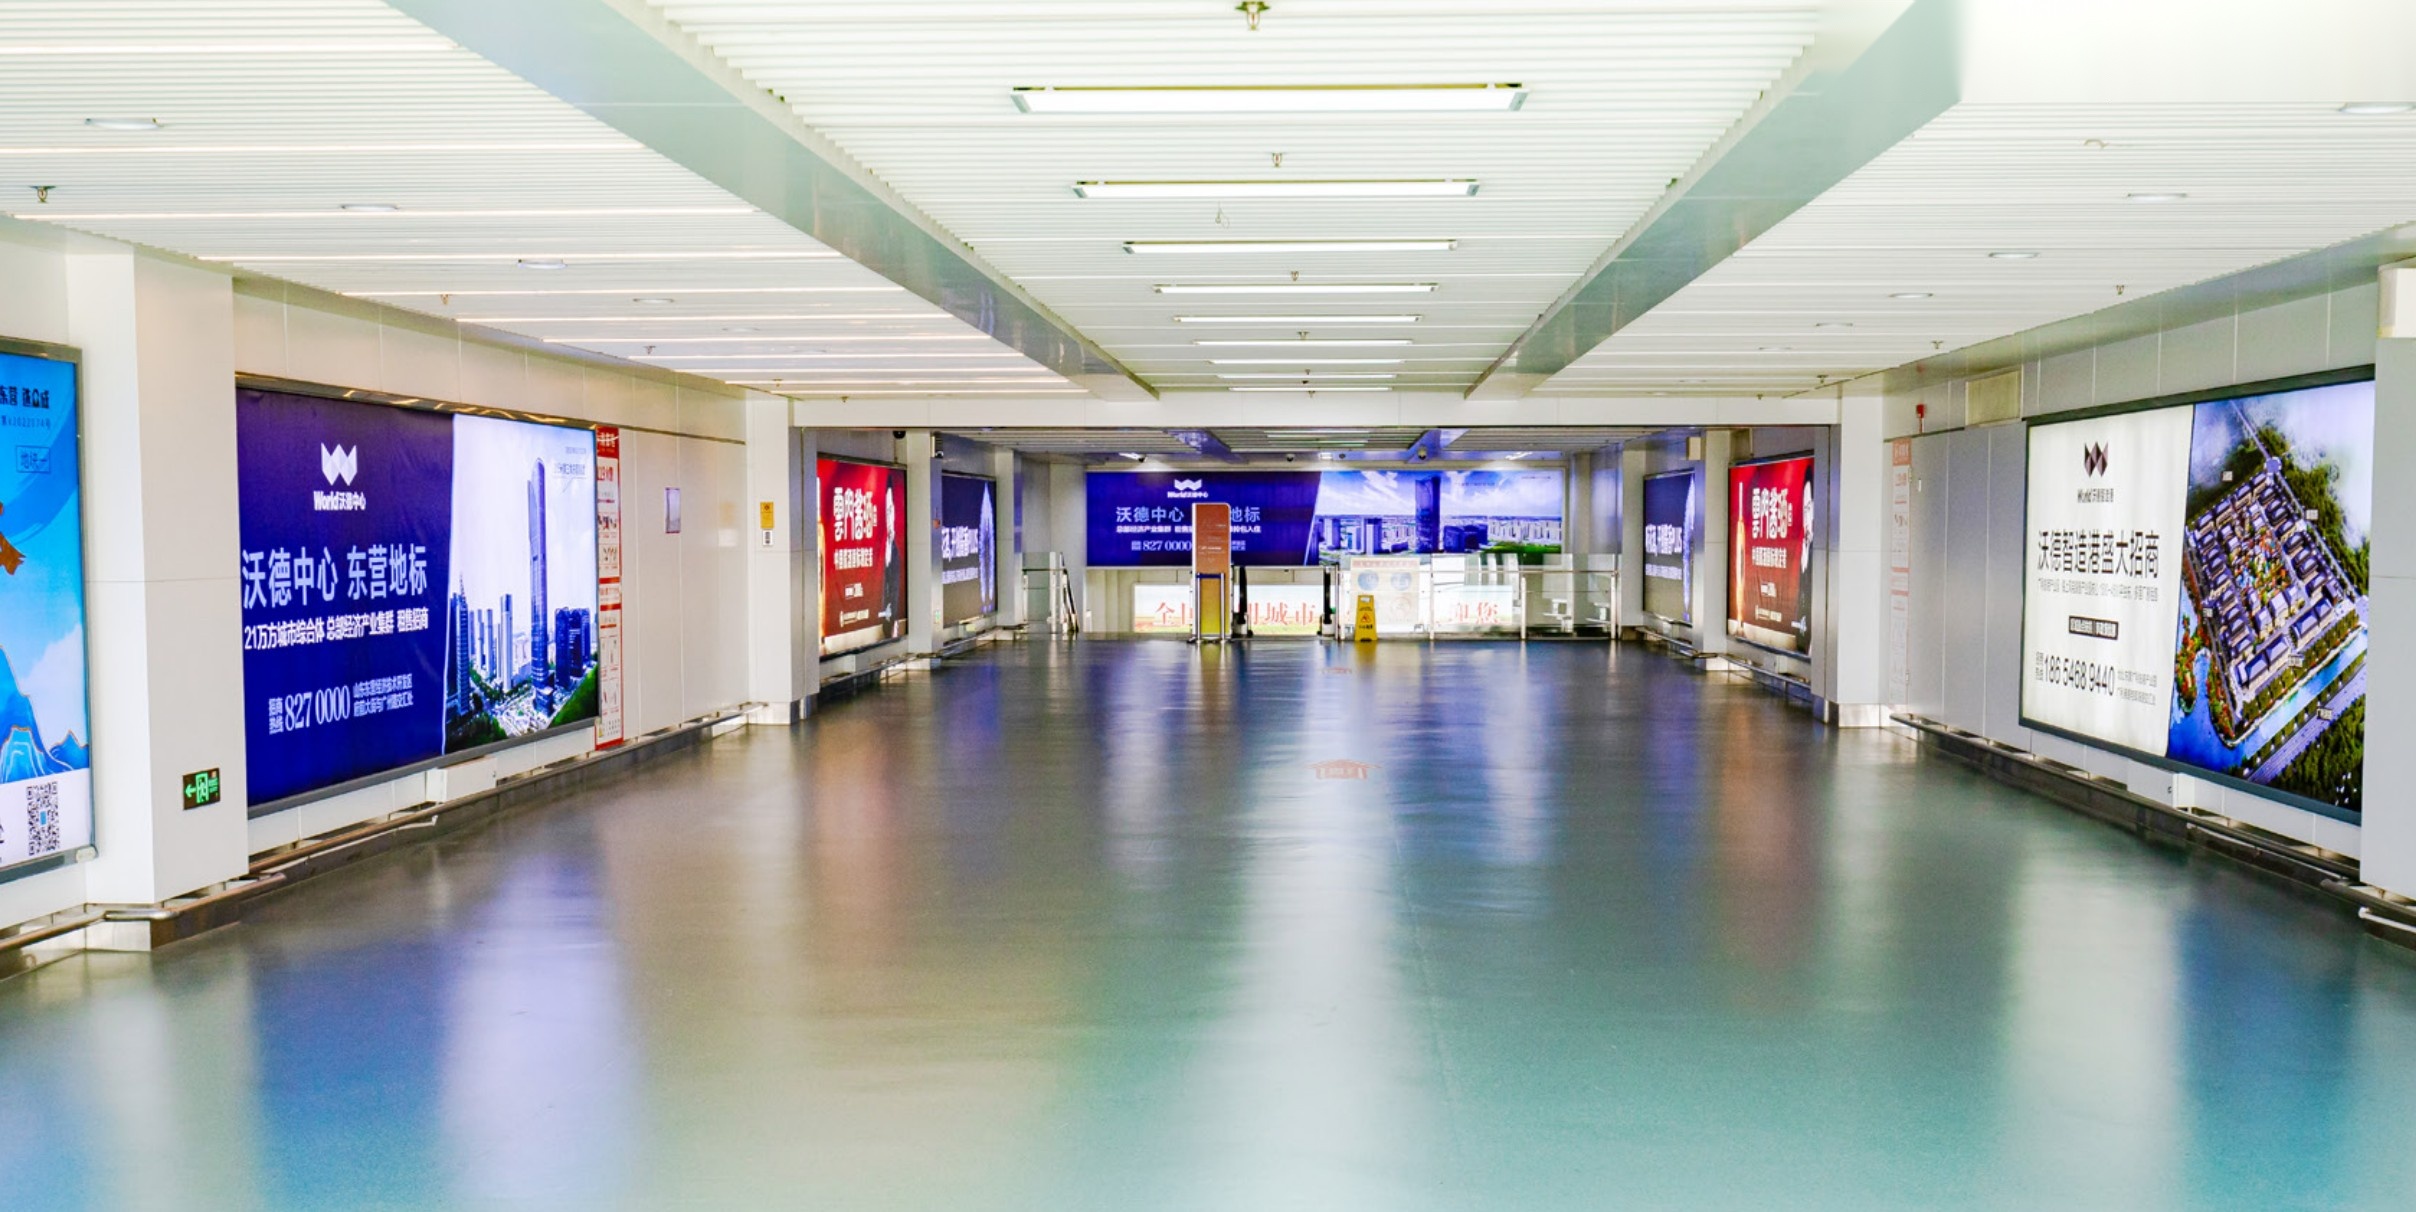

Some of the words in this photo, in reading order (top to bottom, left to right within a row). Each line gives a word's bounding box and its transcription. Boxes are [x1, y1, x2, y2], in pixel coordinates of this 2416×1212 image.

[1116, 506, 1185, 523] 沃德中心
[1142, 541, 1162, 551] 827
[1164, 541, 1192, 551] 0000
[2038, 529, 2159, 578] 沃德智造港盛大招商
[242, 546, 338, 609] 沃德中心
[347, 543, 427, 600] 东营地标
[244, 617, 325, 650] 21万方城市综合体
[326, 610, 394, 640] 总部经济产业集群
[396, 607, 429, 632] 租售招商
[2044, 655, 2061, 683] 186
[2063, 658, 2087, 690] 5468
[2089, 662, 2115, 696] 9440
[285, 692, 312, 731] 827
[315, 685, 350, 725] 0000
